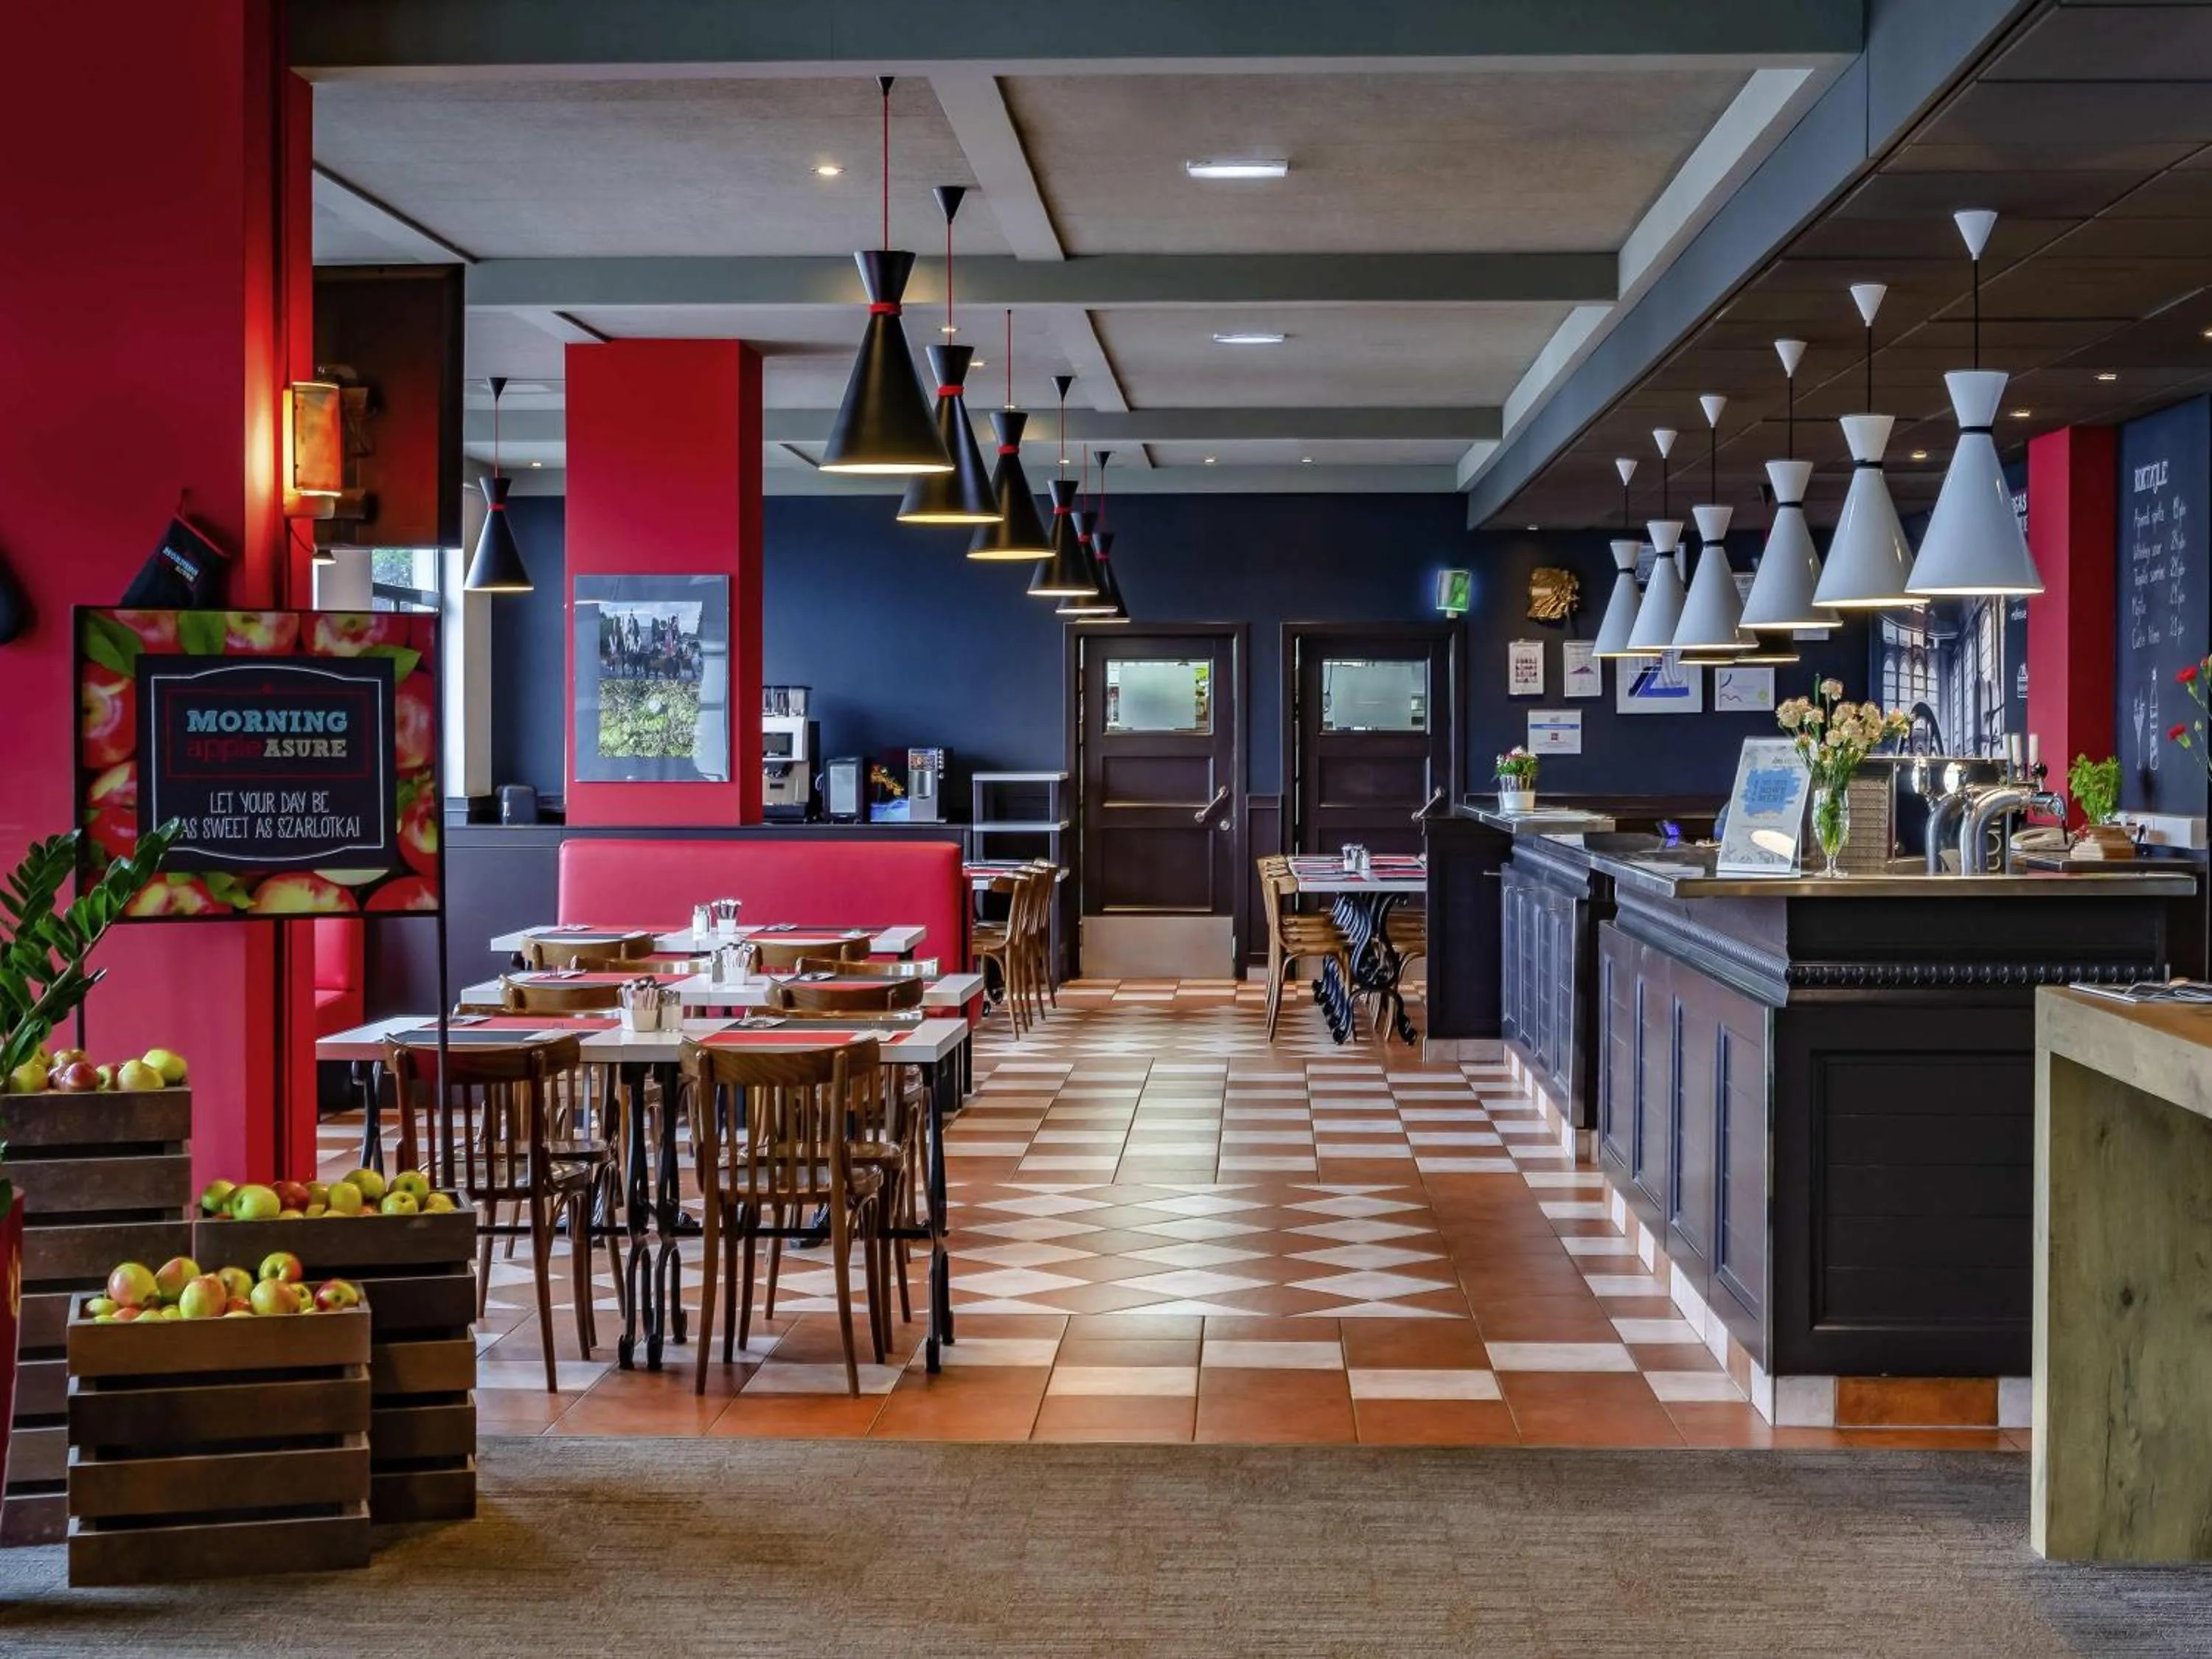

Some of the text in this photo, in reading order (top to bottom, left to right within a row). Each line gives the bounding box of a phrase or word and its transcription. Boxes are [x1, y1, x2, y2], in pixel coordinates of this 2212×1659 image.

[187, 709, 348, 732] MORNING
[210, 790, 330, 813] LET YOUR DAY BE
[181, 817, 198, 839] AS
[203, 817, 249, 838] SWEET
[255, 816, 273, 838] AS
